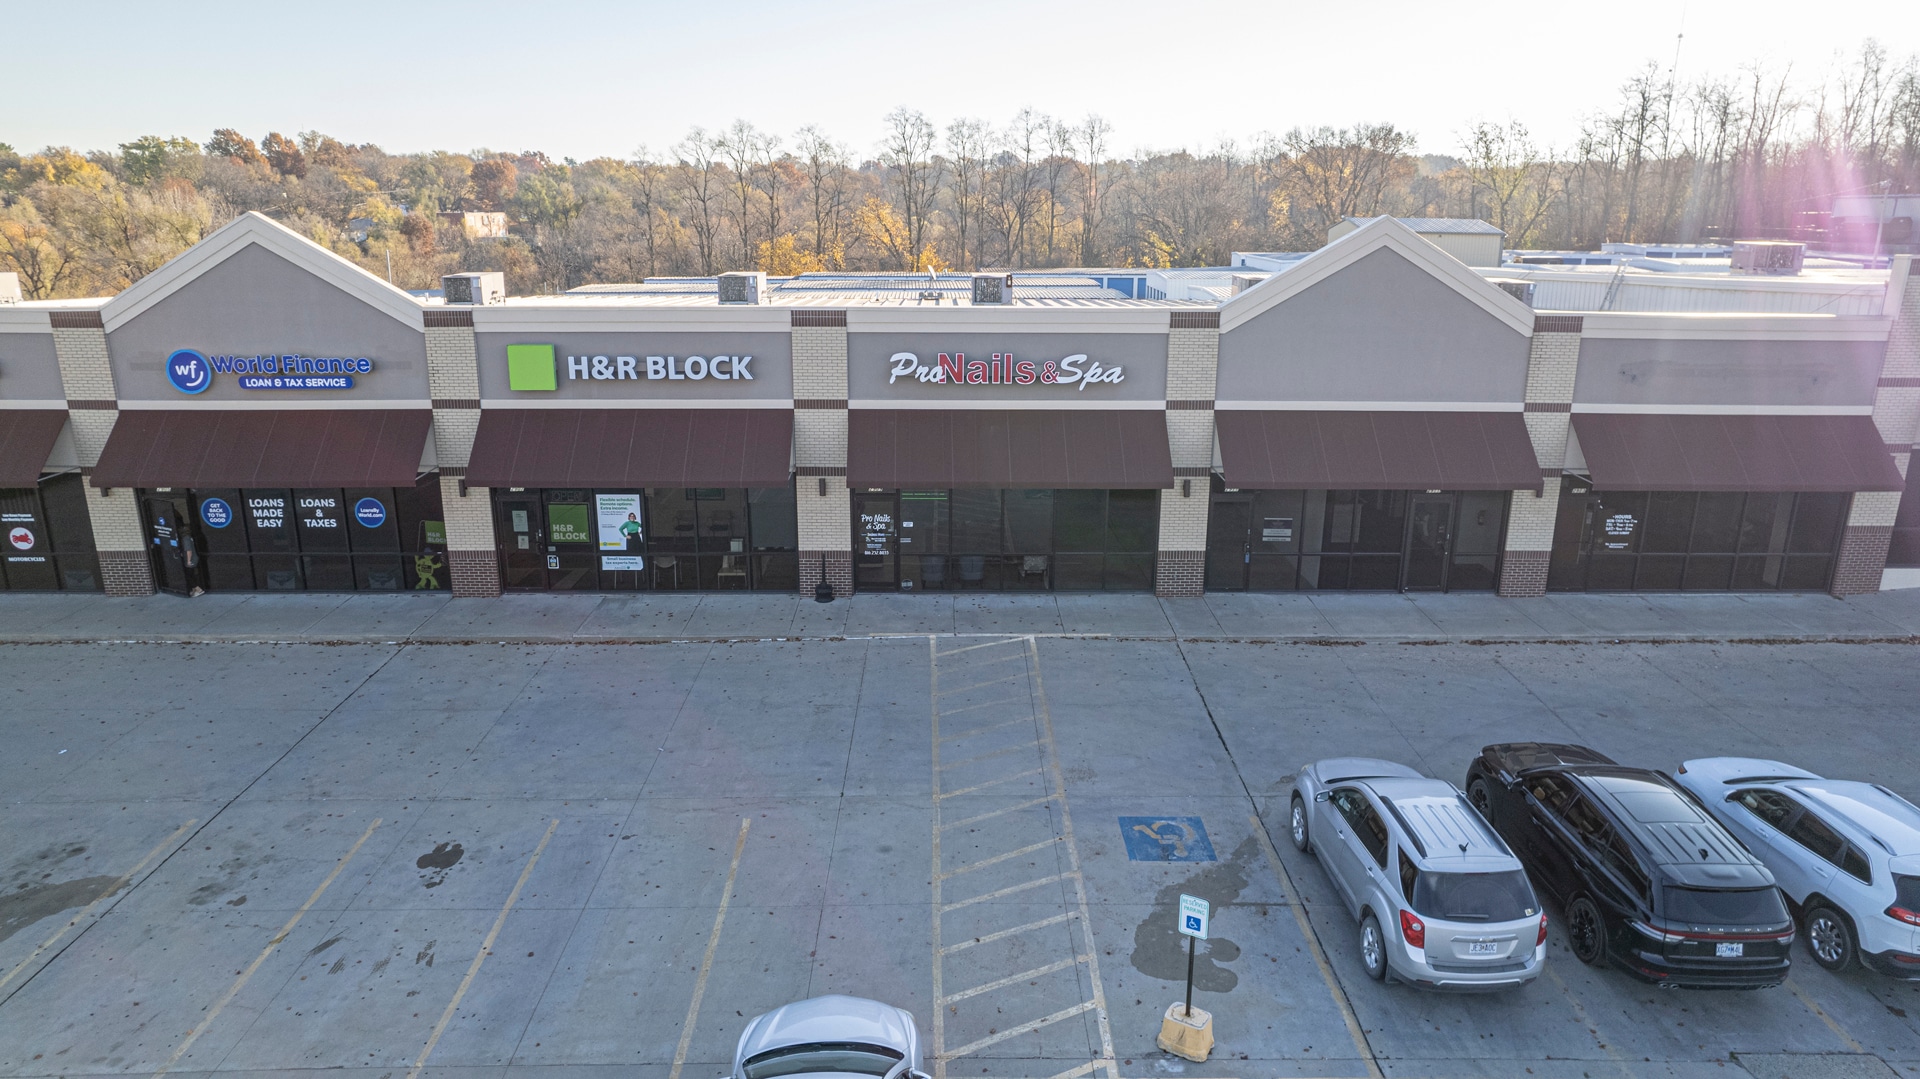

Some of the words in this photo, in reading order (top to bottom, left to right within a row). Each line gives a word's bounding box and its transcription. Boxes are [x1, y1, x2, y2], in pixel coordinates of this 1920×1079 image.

[210, 354, 278, 374] World
[281, 353, 371, 374] Finance
[567, 355, 638, 380] H&R
[646, 355, 754, 380] BLOCK
[175, 360, 197, 379] wf
[889, 352, 946, 384] Pro
[937, 353, 1037, 385] Nails
[1040, 360, 1060, 385] &
[1057, 354, 1124, 391] Spa
[245, 378, 272, 387] LOAN
[274, 378, 282, 387] &
[284, 378, 303, 387] TAX
[305, 378, 346, 387] SERVICE
[248, 498, 284, 507] LOANS
[300, 498, 336, 507] LOANS
[252, 509, 284, 518] MADE
[316, 508, 323, 518] &
[861, 514, 872, 522] Pro
[874, 514, 890, 522] Nails
[256, 519, 283, 528] EASY
[304, 519, 337, 528] TAXES
[552, 524, 574, 532] H&R
[872, 522, 886, 531] Spa
[553, 532, 587, 540] BLOCK
[1182, 898, 1207, 910] RESERVED
[1184, 905, 1205, 915] PARKING
